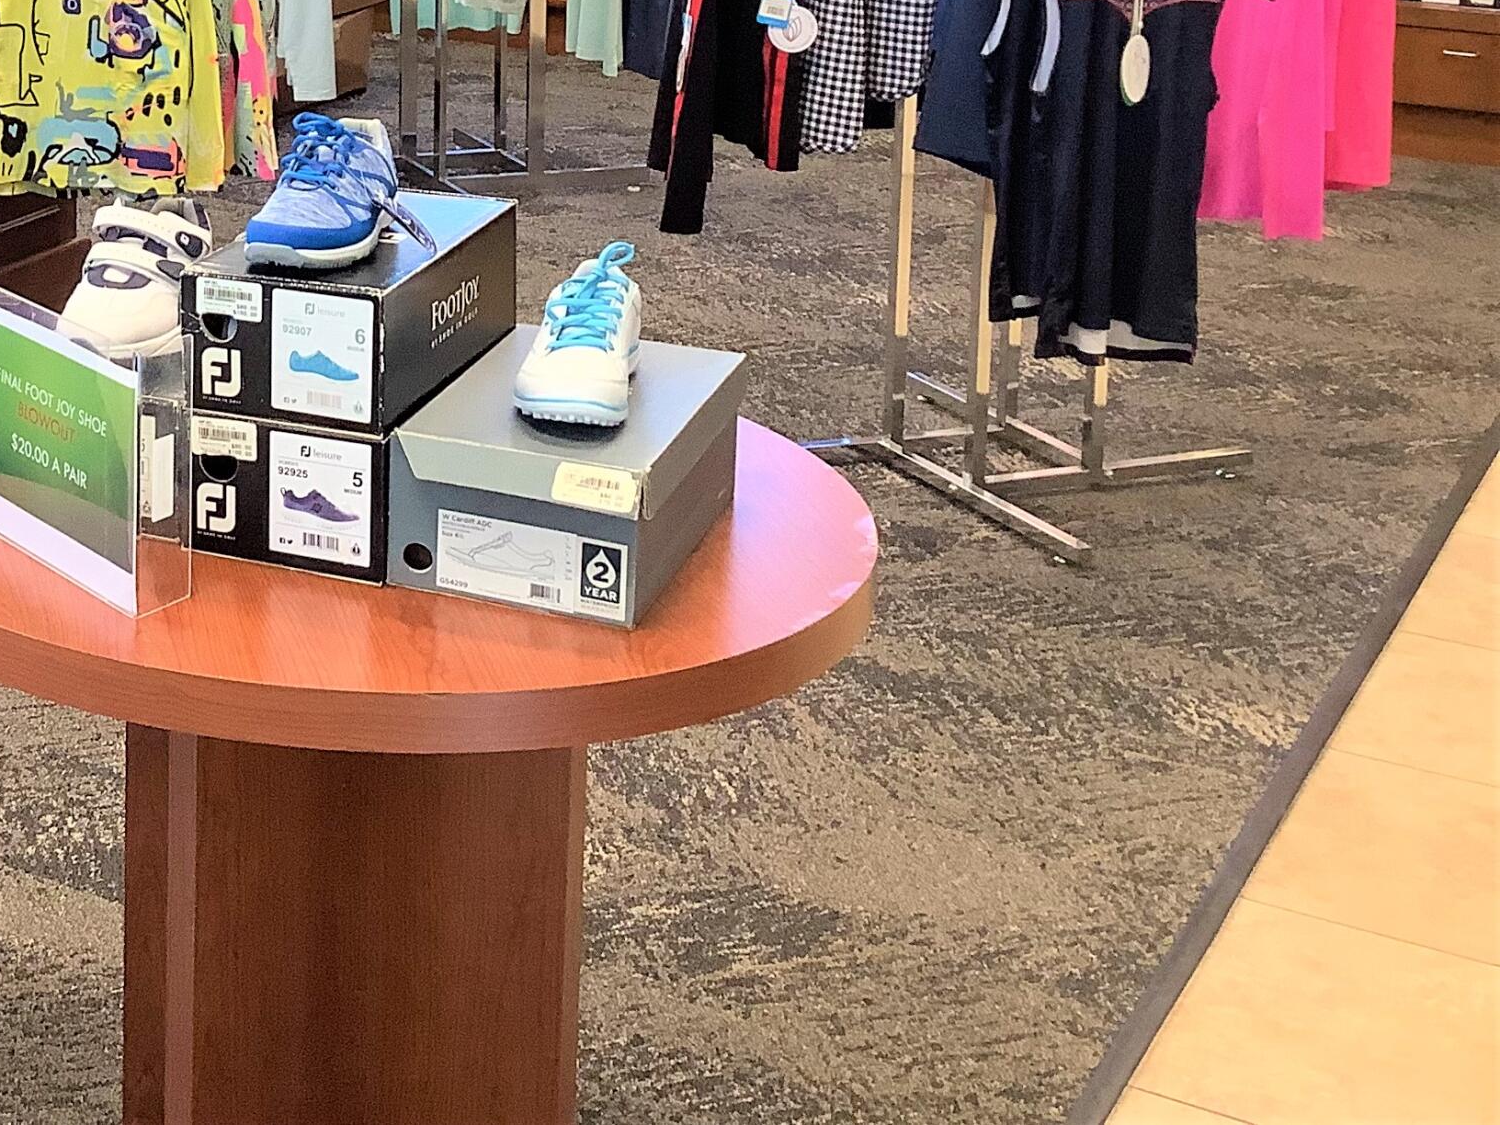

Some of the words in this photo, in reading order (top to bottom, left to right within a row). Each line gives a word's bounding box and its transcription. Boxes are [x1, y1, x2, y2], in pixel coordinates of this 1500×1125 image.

[354, 328, 367, 345] 6
[201, 346, 242, 397] FJ
[18, 401, 76, 443] BLOWOUT
[25, 381, 54, 409] FOOT
[56, 396, 77, 420] JOY
[78, 408, 107, 438] SHOE
[11, 432, 50, 469] $20.00
[52, 457, 61, 475] A
[63, 464, 88, 491] PAIR
[300, 445, 311, 458] FJ
[313, 449, 343, 462] leisure
[277, 466, 309, 479] 92925
[352, 471, 363, 488] 5
[197, 482, 237, 534] FJ
[593, 562, 610, 582] 2
[583, 585, 618, 602] YEAR
